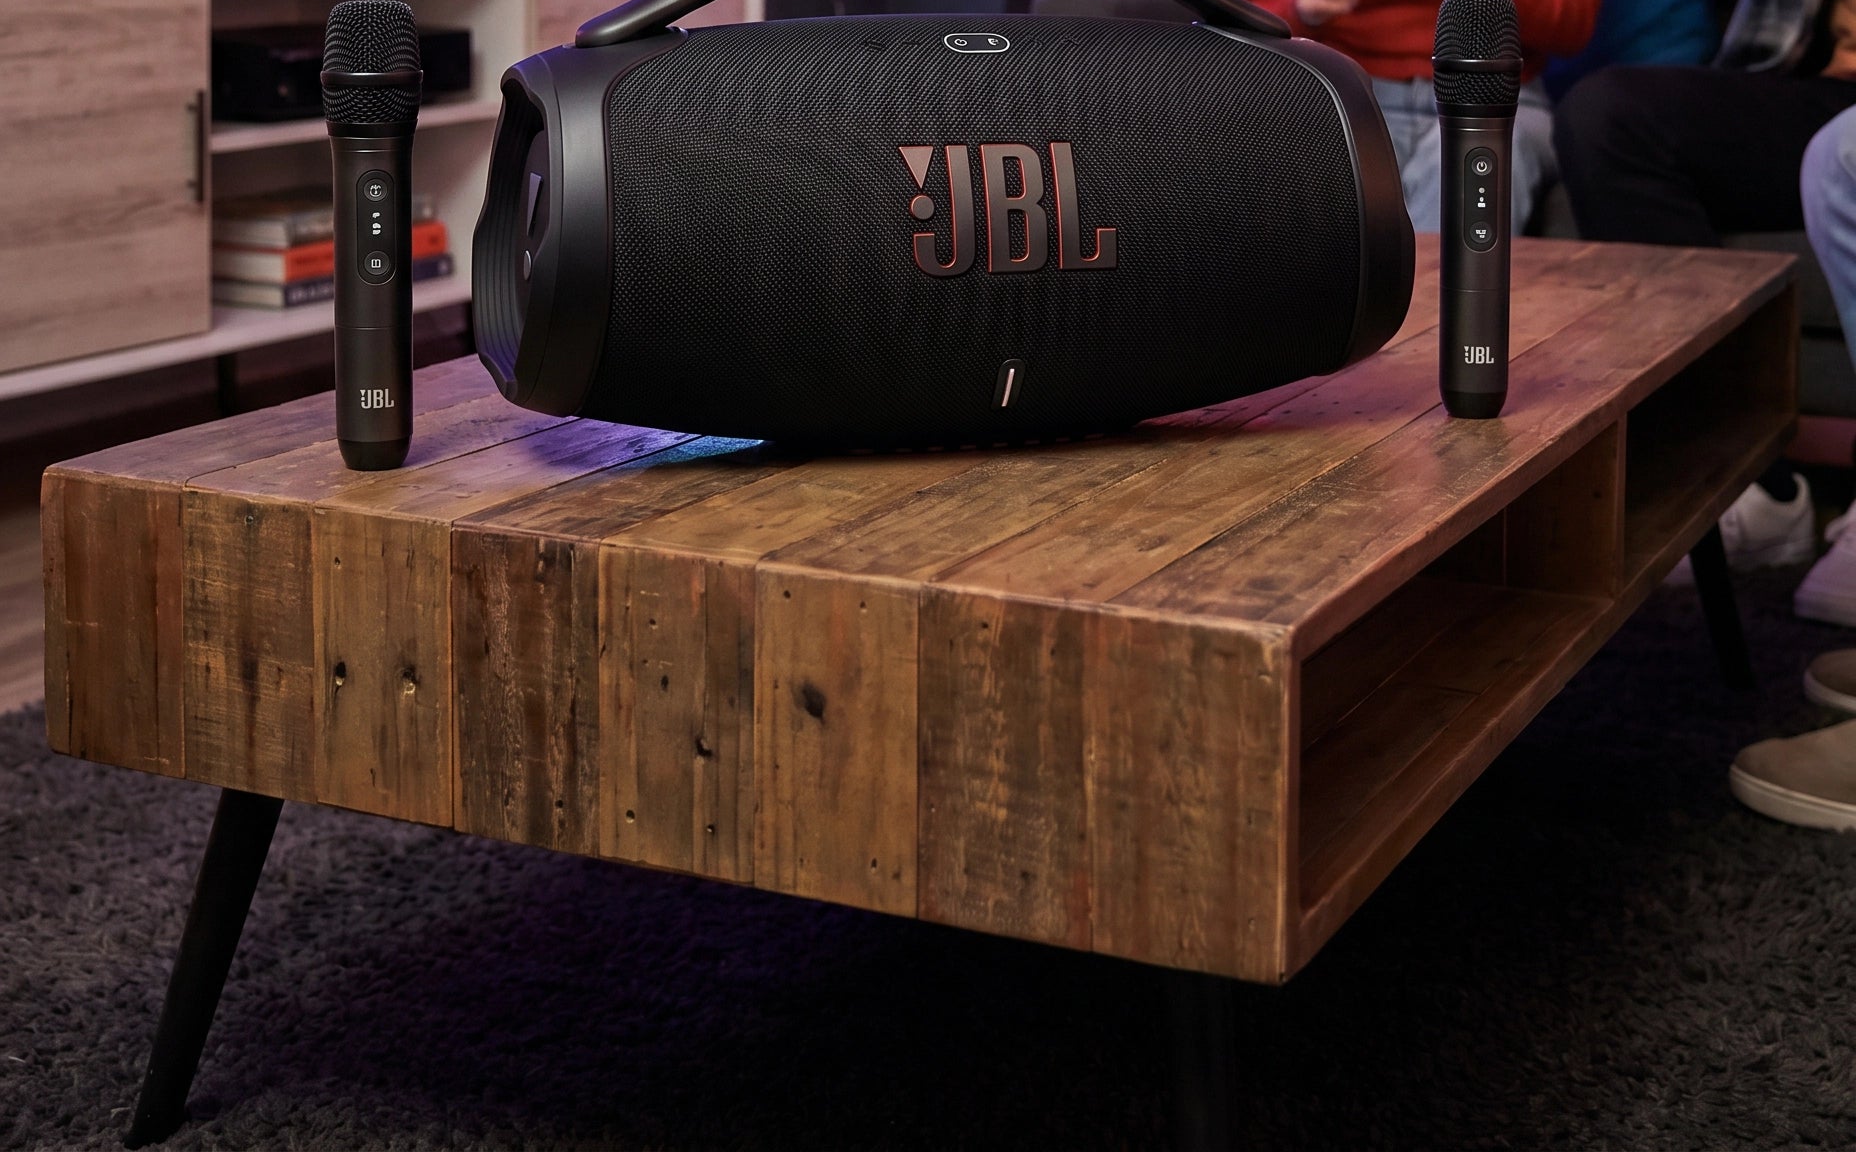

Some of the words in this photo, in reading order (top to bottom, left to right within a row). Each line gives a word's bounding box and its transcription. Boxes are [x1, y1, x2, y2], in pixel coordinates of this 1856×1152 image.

[900, 142, 1118, 277] JBL
[1464, 346, 1494, 364] JBL
[360, 388, 395, 409] JBL
